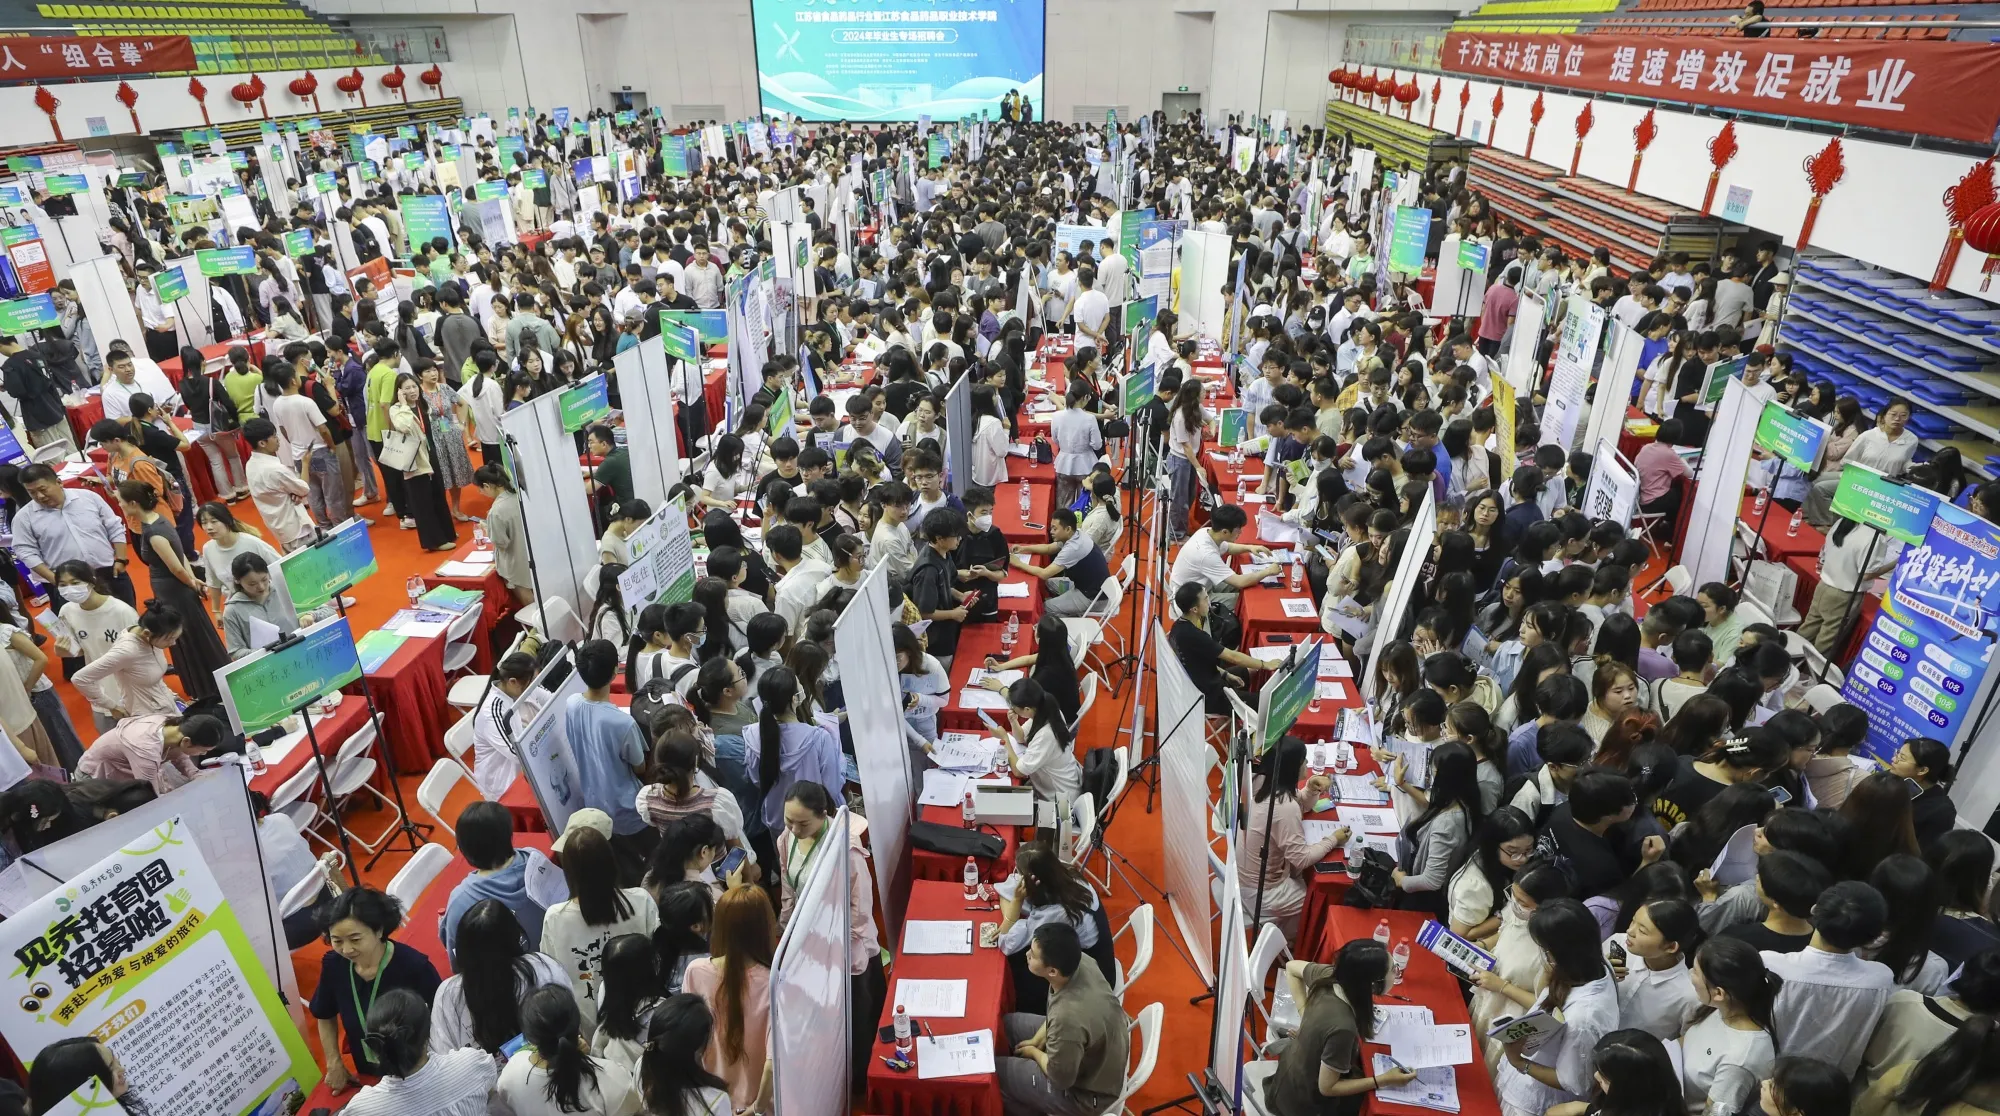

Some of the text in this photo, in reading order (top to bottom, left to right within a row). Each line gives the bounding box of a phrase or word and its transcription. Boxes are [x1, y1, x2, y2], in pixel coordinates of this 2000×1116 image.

[842, 30, 945, 42] 2024年毕业生专场招聘会
[1458, 39, 1917, 112] 千方百计拓岗位 提速增效促就业
[1870, 500, 1894, 514] 有限公司
[623, 564, 650, 591] 包吃住
[1902, 632, 1917, 646] 50名
[1893, 648, 1908, 662] 20名
[1887, 665, 1902, 679] 10名
[1954, 662, 1969, 675] 10名
[1920, 664, 1961, 693] 电商客服 10名
[1879, 680, 1895, 693] 20名
[1938, 696, 1954, 709] 10名
[1907, 694, 1946, 726] 执业药师 20名
[538, 866, 546, 874] A
[13, 858, 175, 979] 见乔托育园
[57, 900, 172, 990] 招募啦
[58, 913, 201, 1021] 奔赴一场爱 与被爱的旅行
[1706, 1048, 1712, 1056] 6
